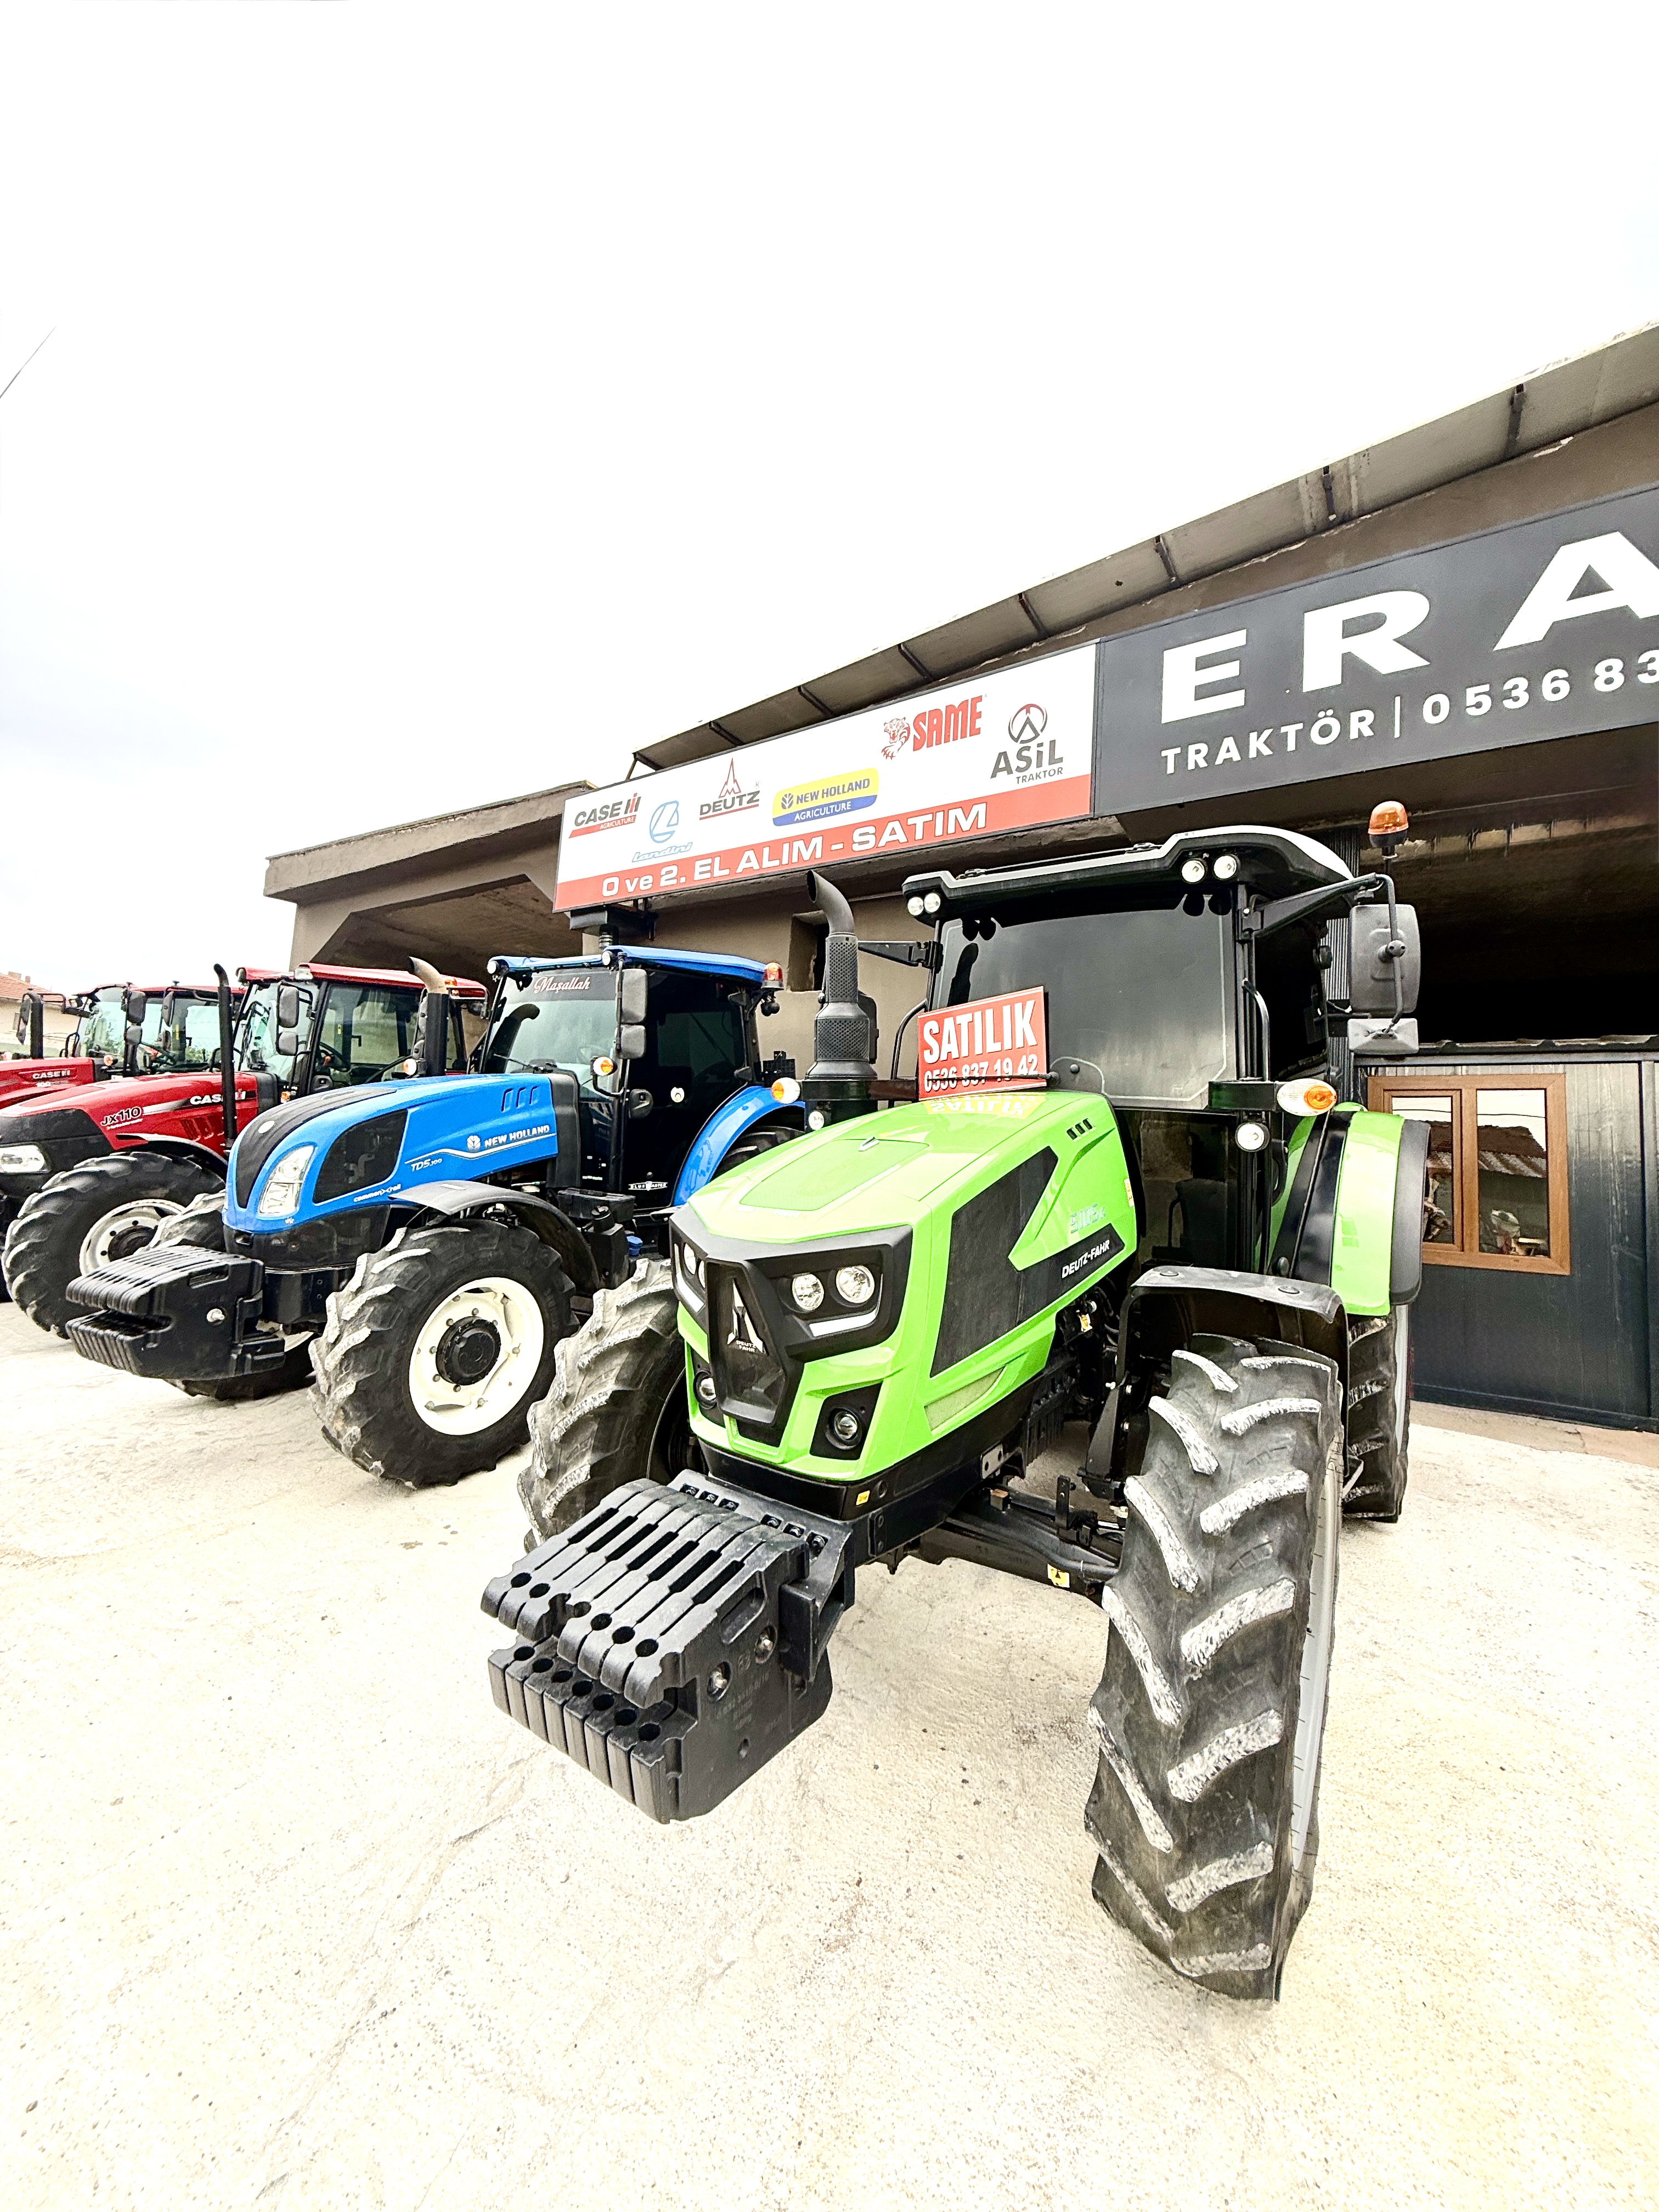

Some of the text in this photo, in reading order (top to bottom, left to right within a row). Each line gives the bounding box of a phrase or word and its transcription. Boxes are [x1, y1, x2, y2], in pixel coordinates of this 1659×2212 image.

[1161, 532, 1659, 724] ERA
[913, 695, 983, 752] SAME
[1161, 710, 1374, 775] TRAKTÖR
[1423, 669, 1571, 724] 0536
[1594, 650, 1659, 692] 83
[699, 790, 760, 816] DEUTZ
[796, 778, 870, 804] NEW HOLLAND
[574, 801, 623, 826] CASE
[600, 815, 635, 830] AGRICULTURE
[794, 801, 851, 822] AGRICULTURE
[625, 874, 653, 893] ve
[660, 864, 686, 887] 2.
[694, 855, 730, 881] EL
[736, 835, 823, 873] ALIM
[851, 802, 987, 852] SATIM
[534, 977, 590, 994] Maşallah
[923, 1000, 1037, 1064] SATILIK
[32, 1070, 61, 1079] CASE
[924, 1054, 1039, 1092] 0536 837 19 42
[484, 1125, 550, 1148] NEW HOLLAND
[1062, 1240, 1109, 1279] DEUTZ-FAHR
